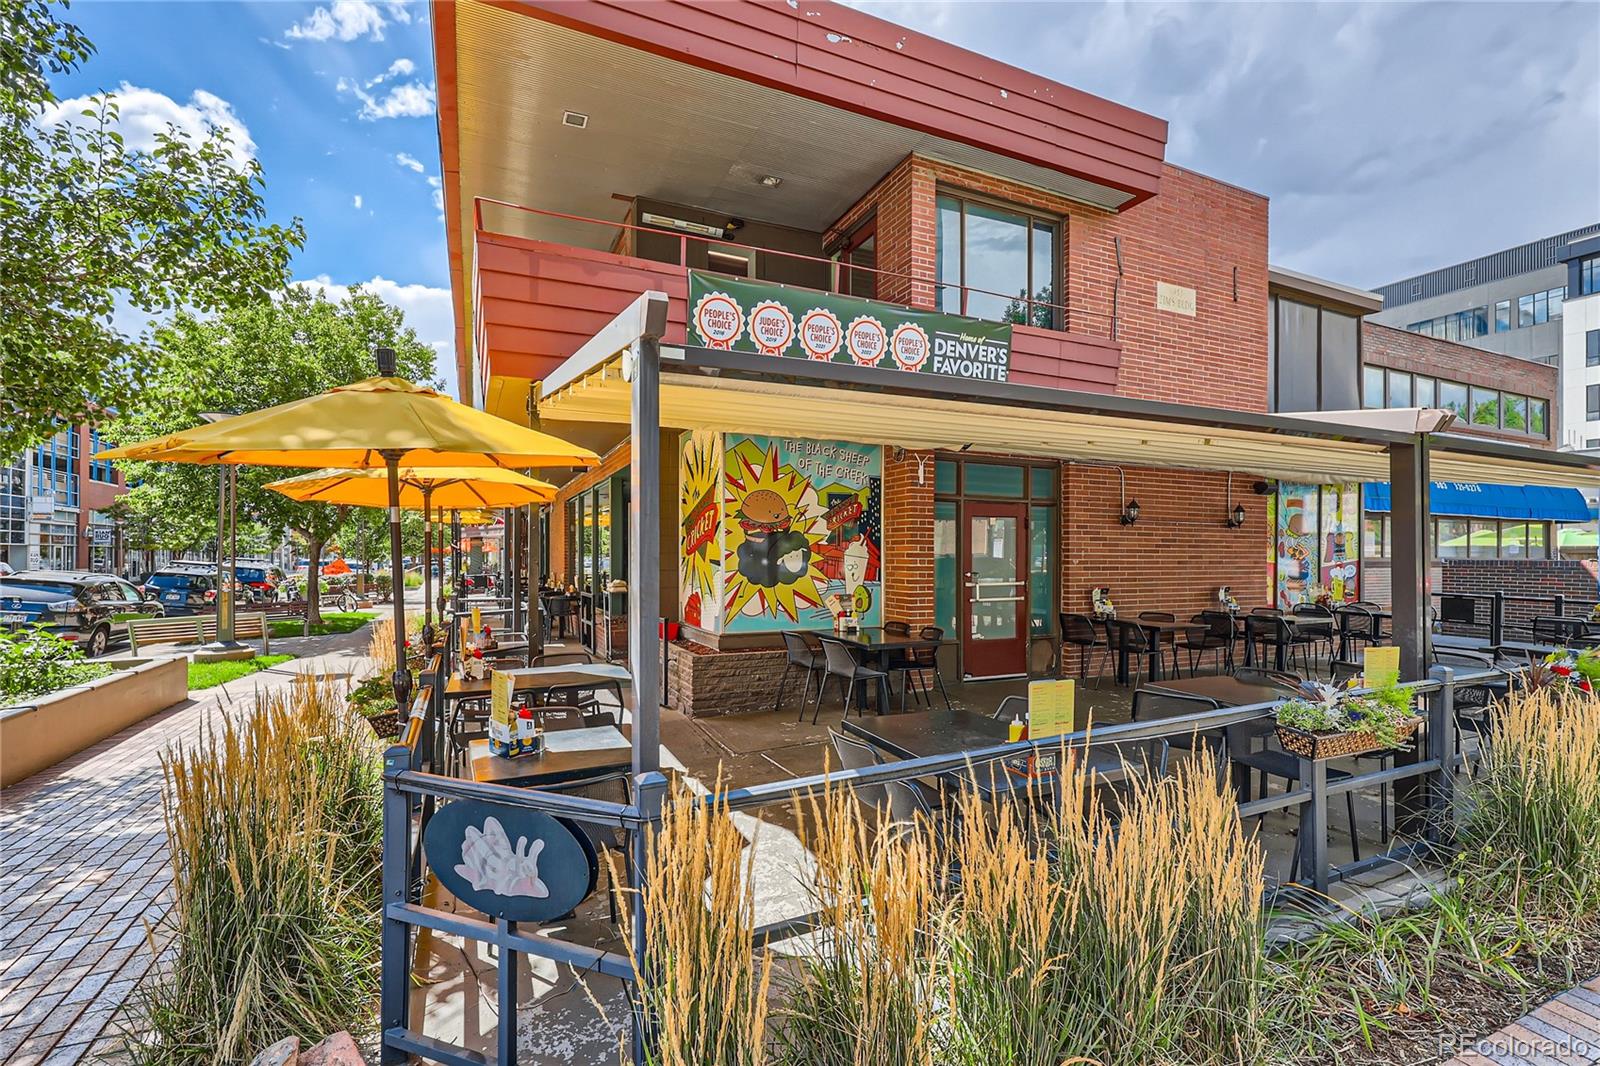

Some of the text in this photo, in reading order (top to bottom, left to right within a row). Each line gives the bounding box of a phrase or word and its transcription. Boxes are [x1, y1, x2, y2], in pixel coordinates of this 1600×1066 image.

[704, 308, 736, 321] PEOPLE'S
[707, 319, 732, 330] CHOICE
[759, 317, 786, 329] JUDGE'S
[760, 326, 784, 337] CHOICE
[807, 324, 835, 336] PEOPLE'S
[854, 330, 880, 342] PEOPLE'S
[810, 333, 832, 344] CHOICE
[898, 337, 923, 348] PEOPLE'S
[960, 332, 986, 345] Home of
[856, 340, 877, 350] CHOICE
[901, 346, 920, 356] CHOICE
[934, 338, 1008, 364] DENVER'S
[933, 356, 1007, 382] FAVORITE
[784, 439, 871, 467] THE BLACK SHEEP
[798, 458, 869, 485] OF THE CREEK
